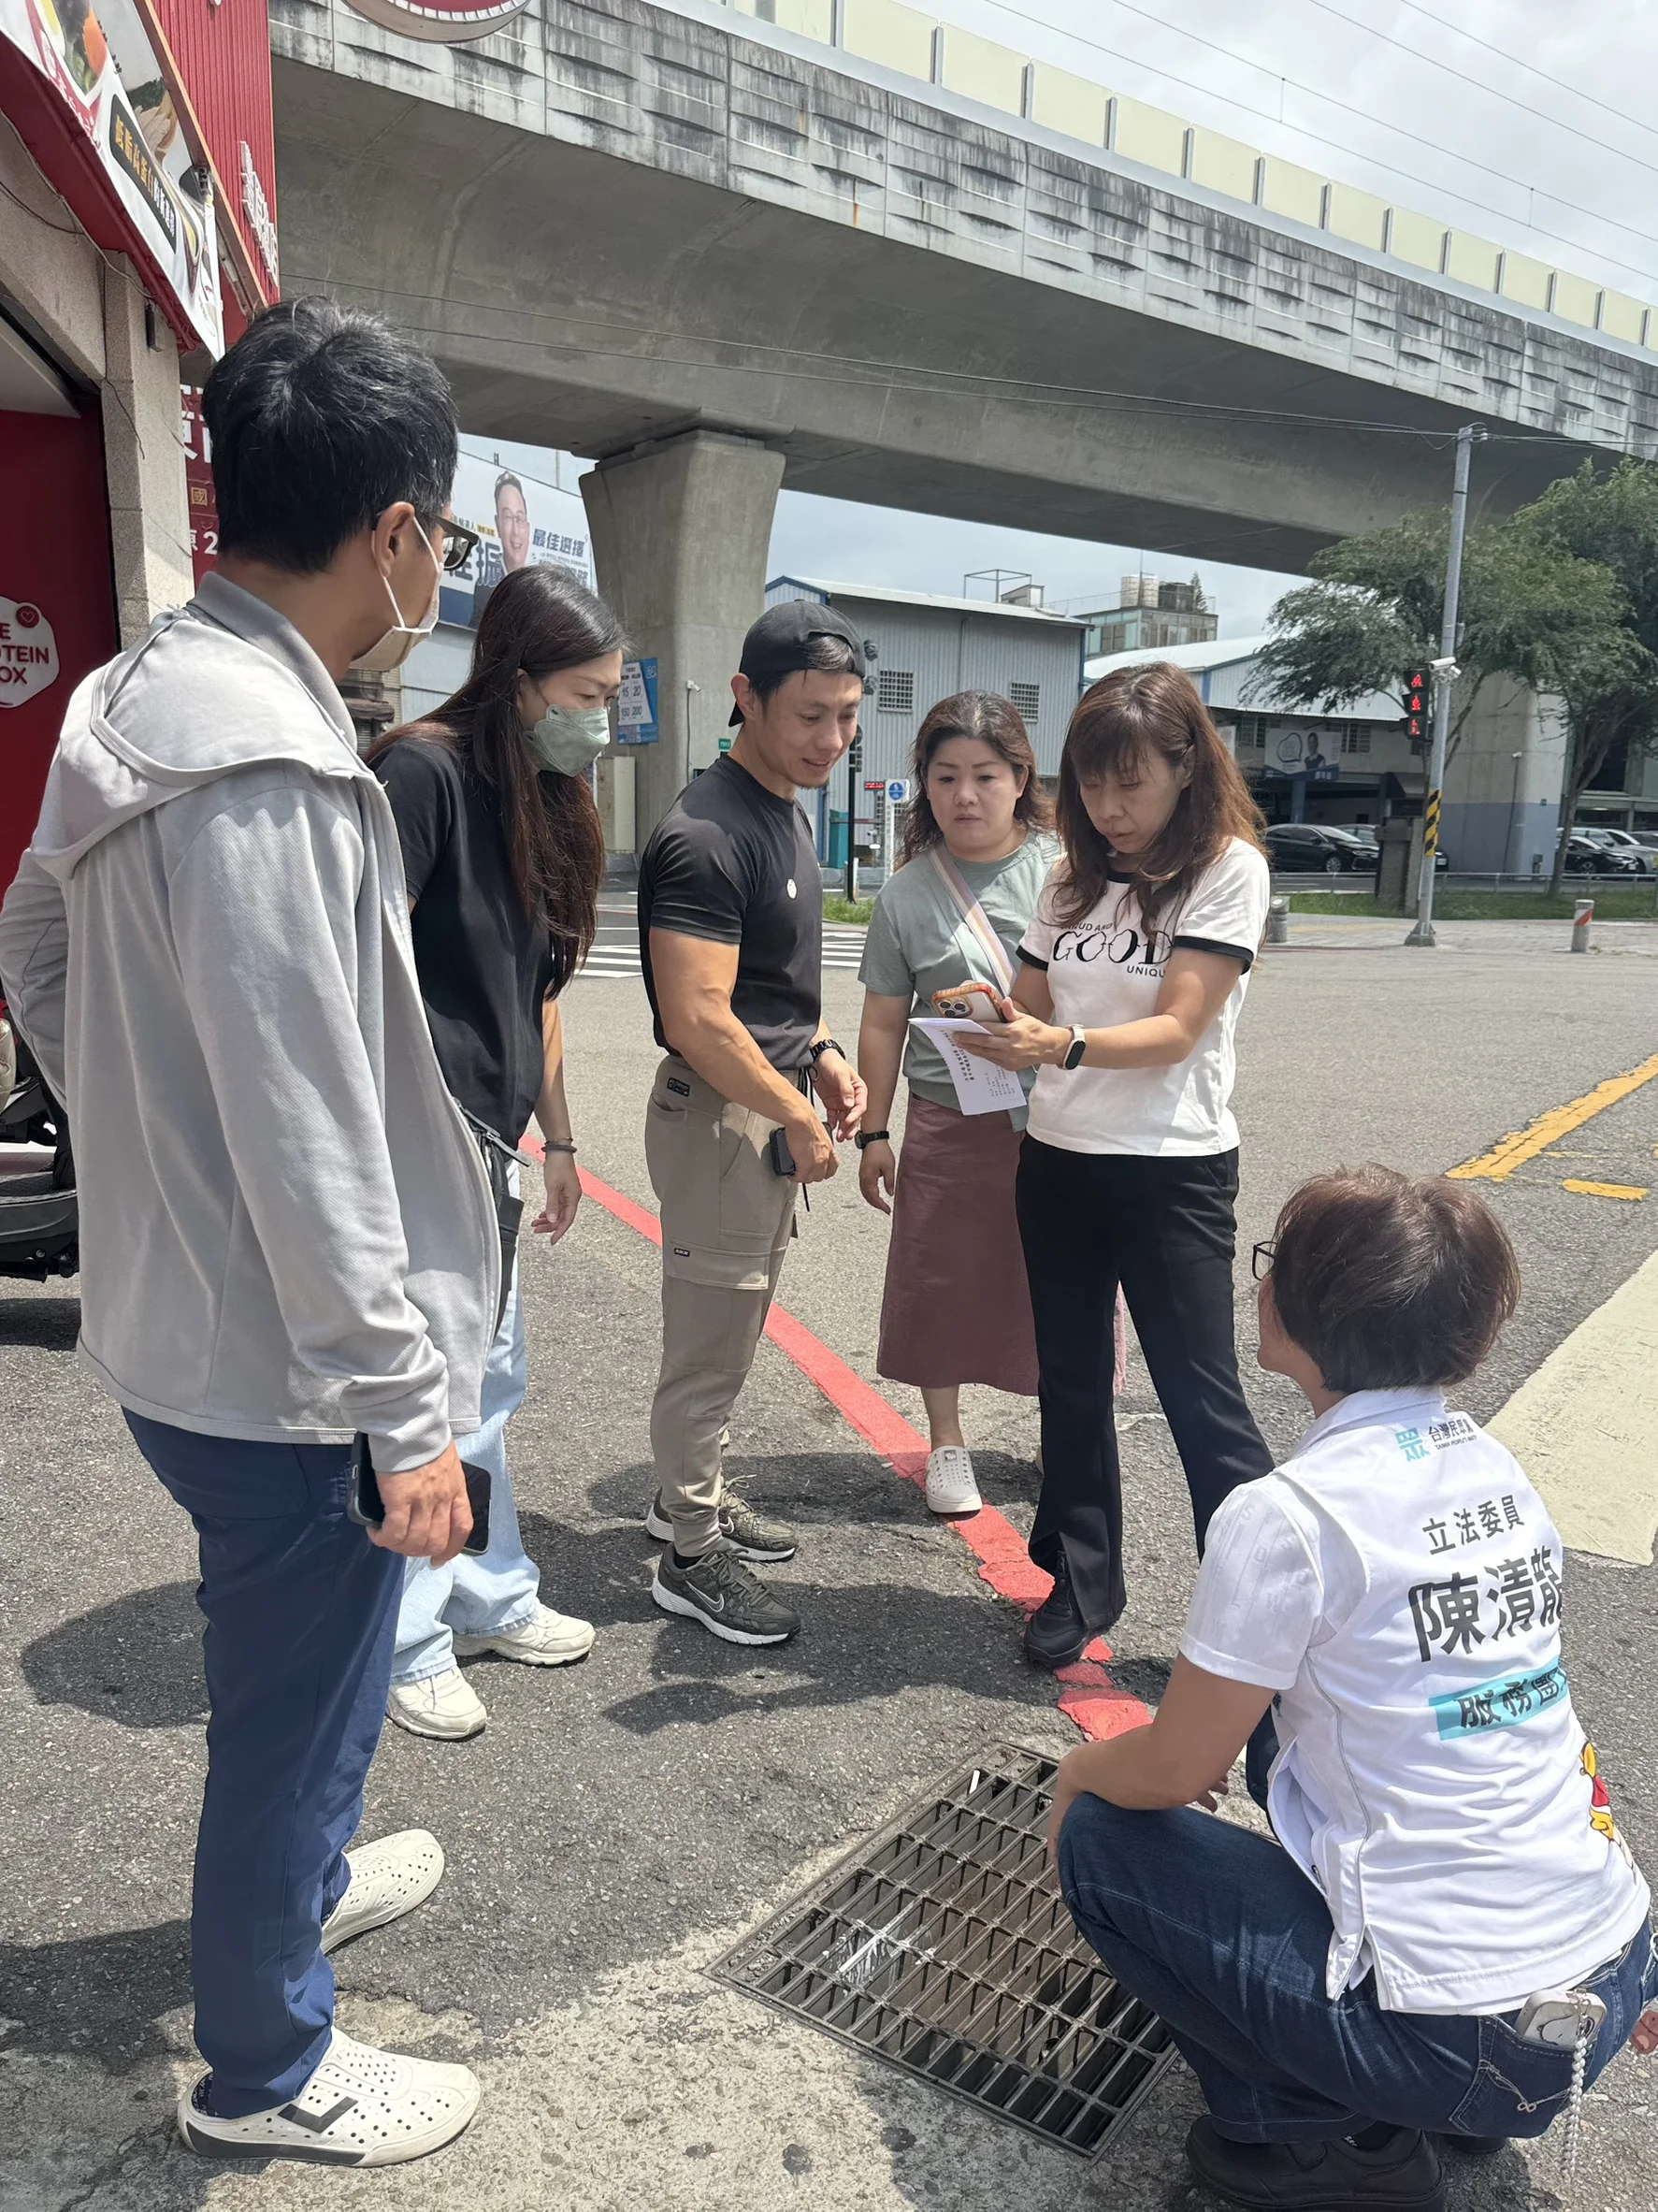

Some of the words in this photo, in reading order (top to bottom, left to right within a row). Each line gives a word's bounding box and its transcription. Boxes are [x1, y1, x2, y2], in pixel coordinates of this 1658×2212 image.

[532, 528, 585, 557] 最佳選擇
[0, 644, 50, 664] TEIN
[1053, 929, 1174, 965] GOOD
[1422, 1495, 1524, 1554] 立法委員
[1453, 1666, 1567, 1728] 服務團
